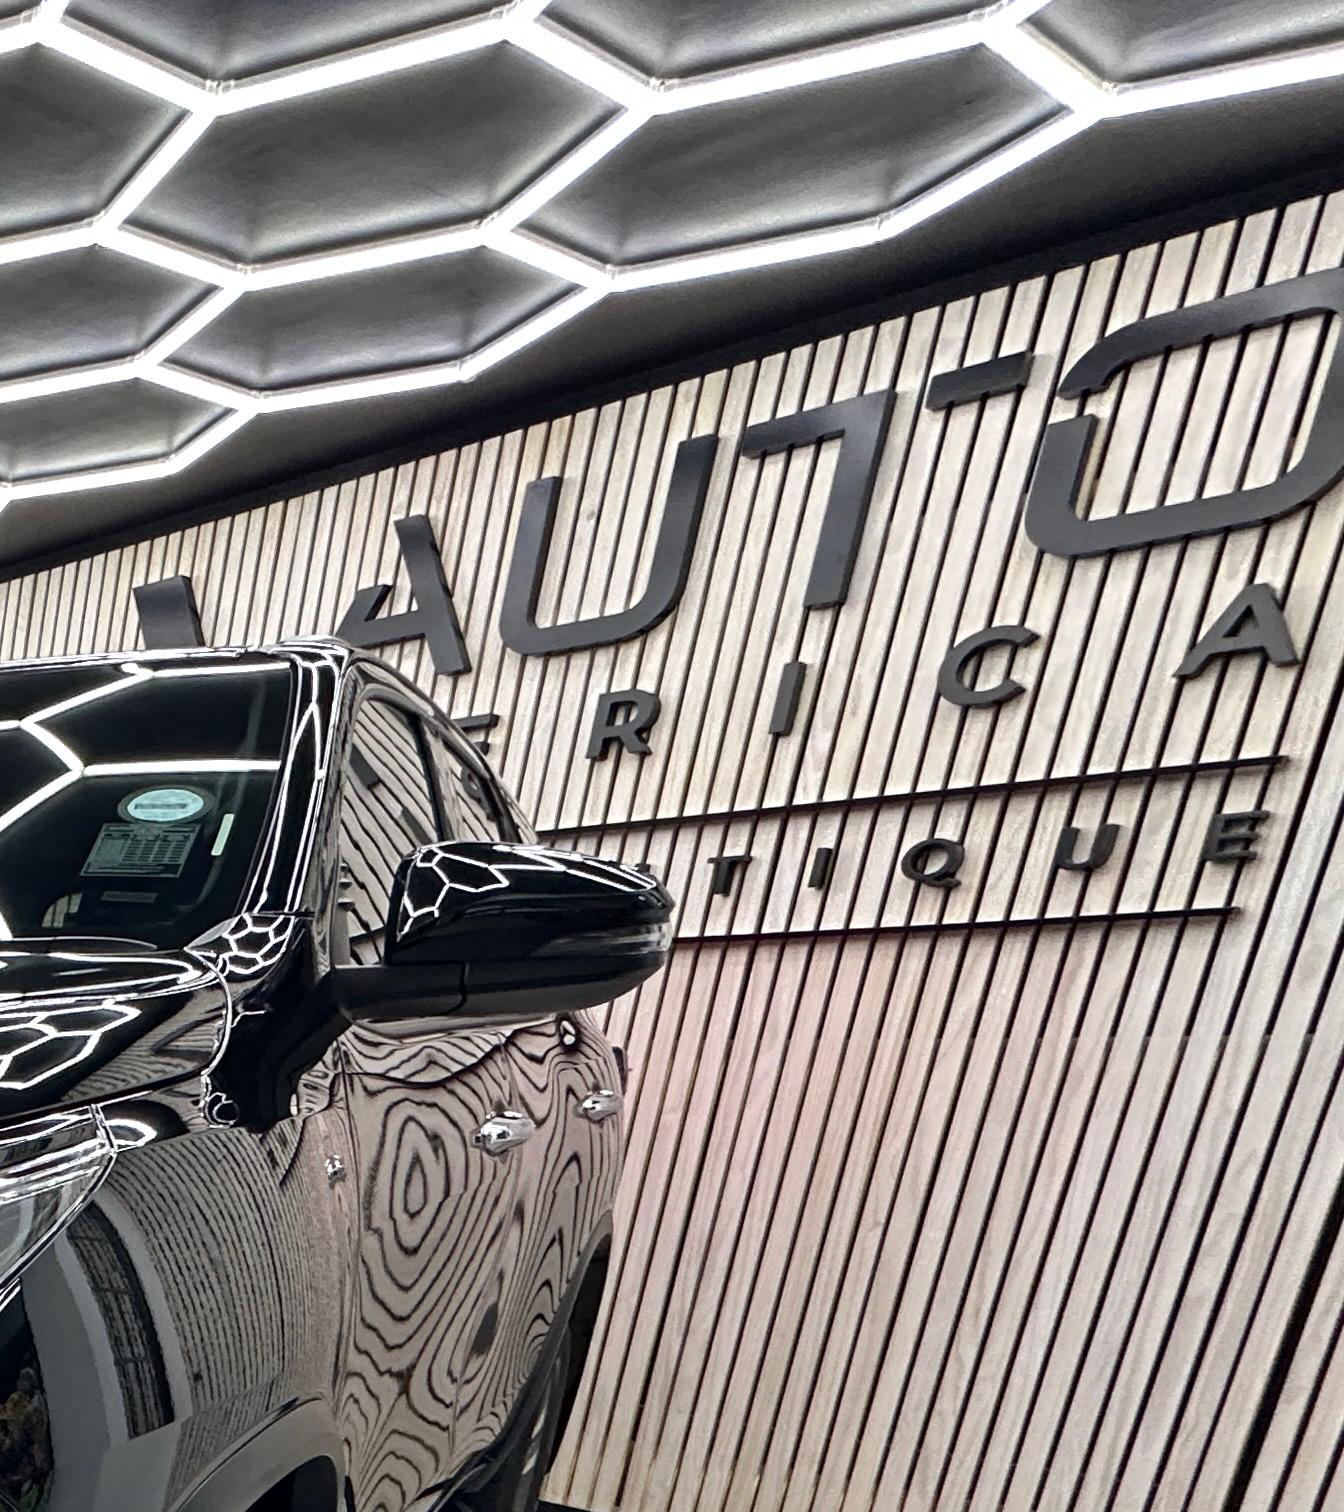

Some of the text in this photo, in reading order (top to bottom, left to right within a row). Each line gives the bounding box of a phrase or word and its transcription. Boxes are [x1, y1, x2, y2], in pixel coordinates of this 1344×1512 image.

[334, 266, 1344, 676] AUTO
[454, 582, 1302, 762] RICA
[709, 808, 1272, 898] TIQUE
